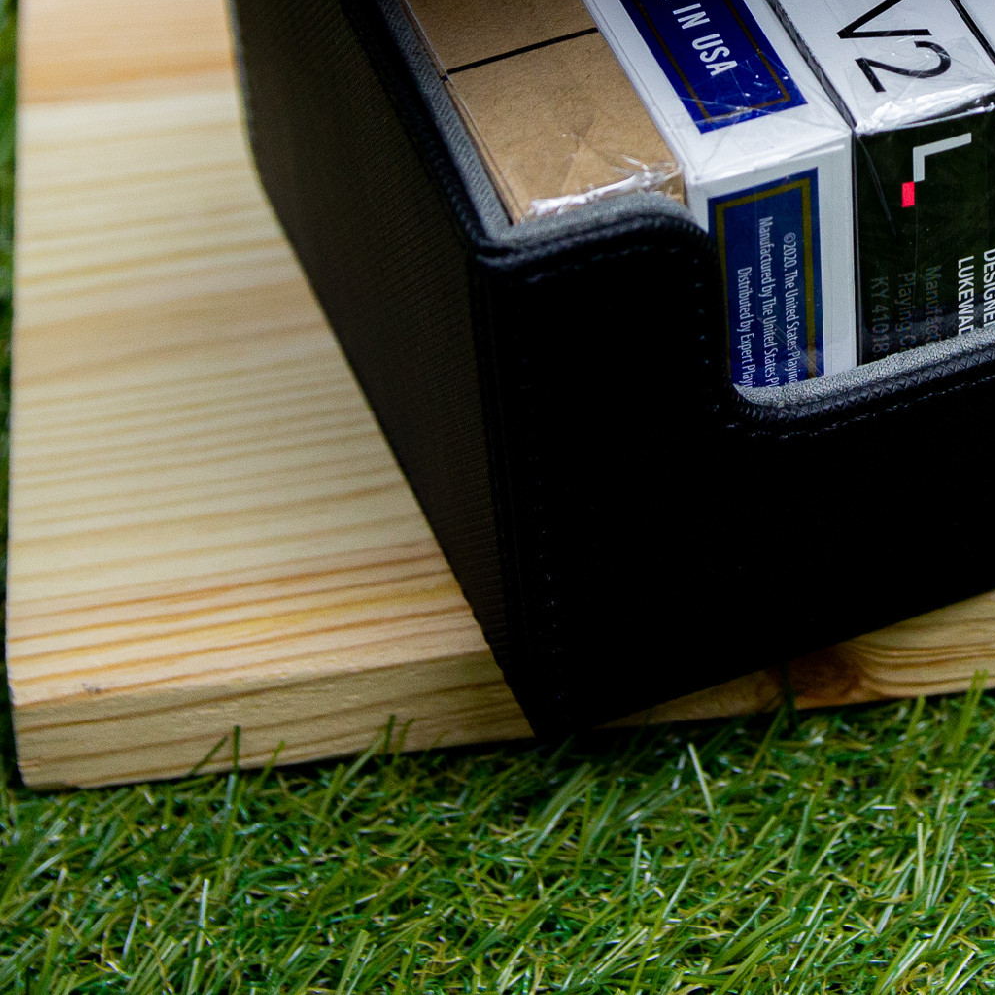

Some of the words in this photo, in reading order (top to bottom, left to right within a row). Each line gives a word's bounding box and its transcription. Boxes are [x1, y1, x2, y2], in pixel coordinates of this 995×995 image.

[672, 3, 710, 30] IN
[691, 33, 738, 76] USA
[758, 216, 776, 284] Manufactured
[737, 266, 754, 319] Distributed
[758, 283, 776, 297] by
[784, 269, 799, 288] The
[871, 276, 889, 299] KY
[762, 296, 777, 316] The
[785, 288, 799, 321] United
[895, 271, 916, 332] Playing
[736, 319, 754, 332] by
[762, 315, 778, 348] United
[786, 321, 800, 350] States
[737, 332, 755, 364] Expert
[763, 347, 779, 377] States
